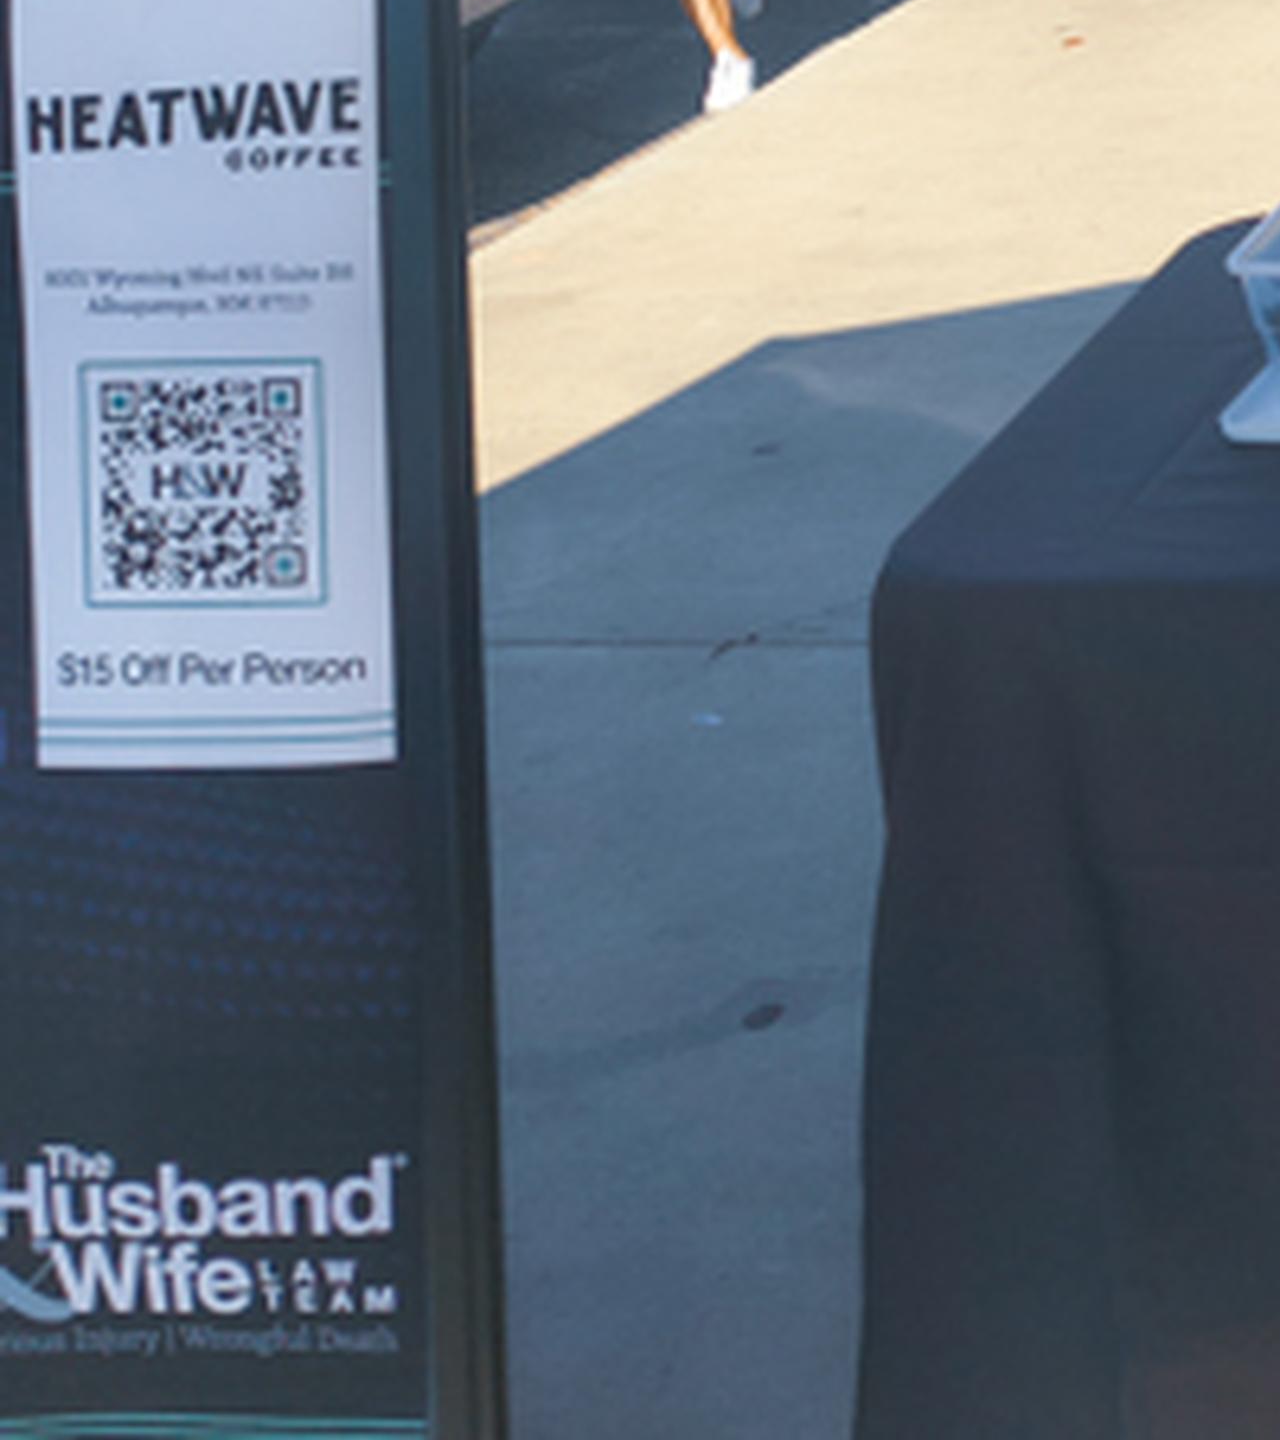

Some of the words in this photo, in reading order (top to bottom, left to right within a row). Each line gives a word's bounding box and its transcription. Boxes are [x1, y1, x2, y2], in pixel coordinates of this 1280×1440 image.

[26, 77, 362, 154] HEATWAVE
[223, 146, 362, 173] COFFEE
[56, 651, 114, 687] $15
[119, 651, 171, 687] Off
[177, 651, 234, 686] Per
[242, 650, 367, 686] Person
[42, 1143, 115, 1180] The
[0, 1154, 393, 1238] Husband
[49, 1240, 252, 1314] Wife
[258, 1260, 357, 1285] LAW
[262, 1285, 397, 1313] TEAM
